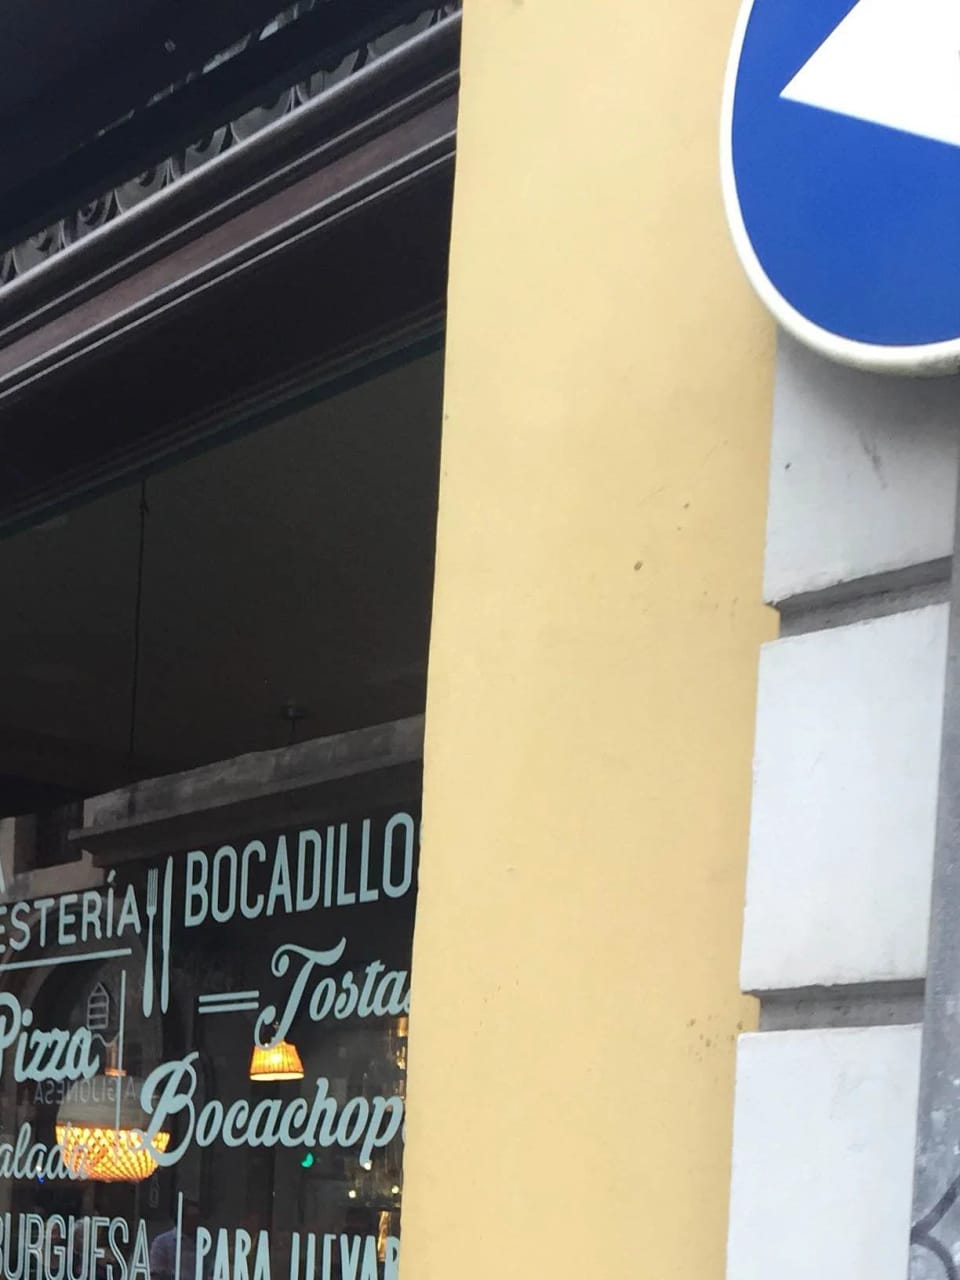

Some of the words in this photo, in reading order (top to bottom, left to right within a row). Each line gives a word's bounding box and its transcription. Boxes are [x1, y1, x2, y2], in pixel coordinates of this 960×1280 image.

[184, 811, 415, 927] BOCADILLO
[254, 937, 412, 1051] Tosta
[130, 1051, 408, 1168] Bocachop
